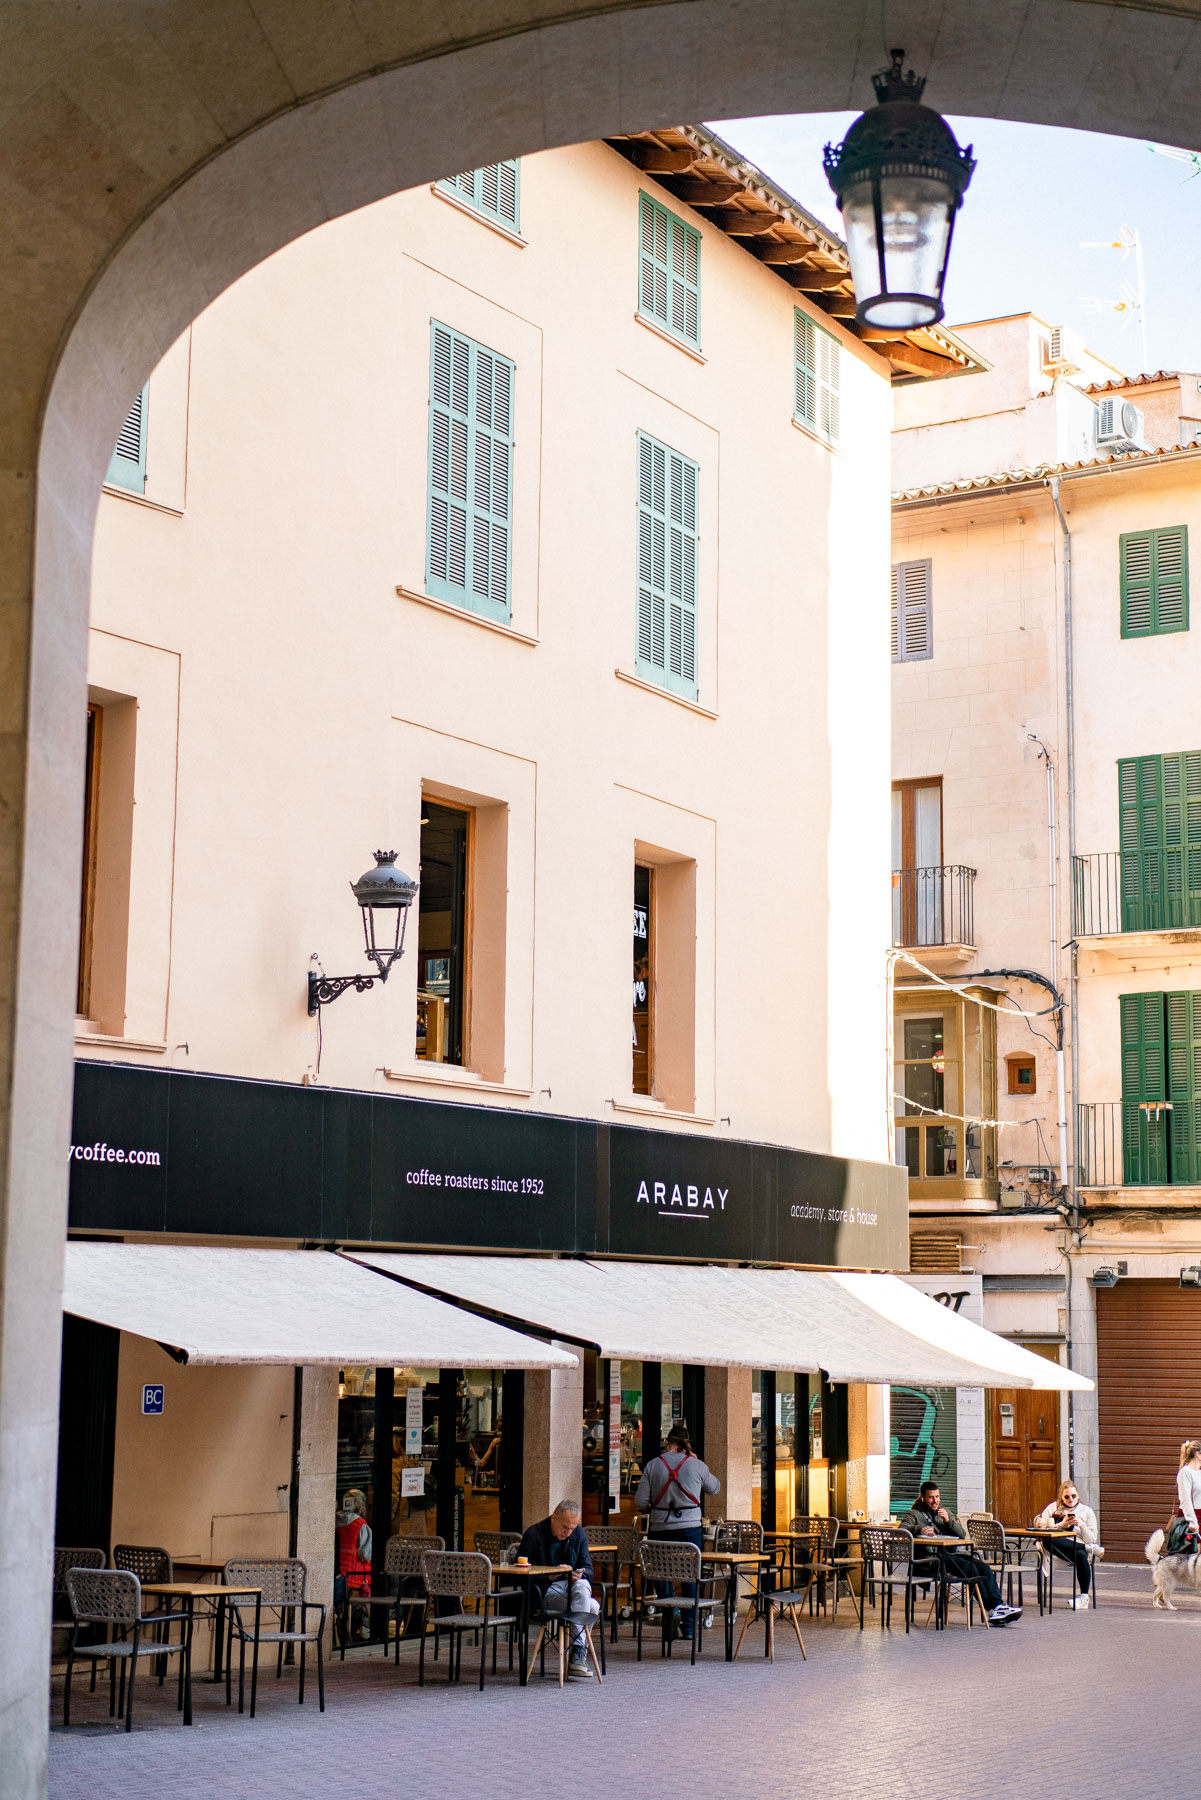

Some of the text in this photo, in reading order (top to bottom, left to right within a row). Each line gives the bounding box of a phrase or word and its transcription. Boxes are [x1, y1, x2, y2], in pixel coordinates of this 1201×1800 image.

[406, 1168, 544, 1195] coffee roasters since 1952
[636, 1180, 729, 1210] ARABAY
[827, 1206, 848, 1223] store
[849, 1207, 855, 1223] &
[856, 1207, 878, 1226] house
[145, 1389, 162, 1405] BC
